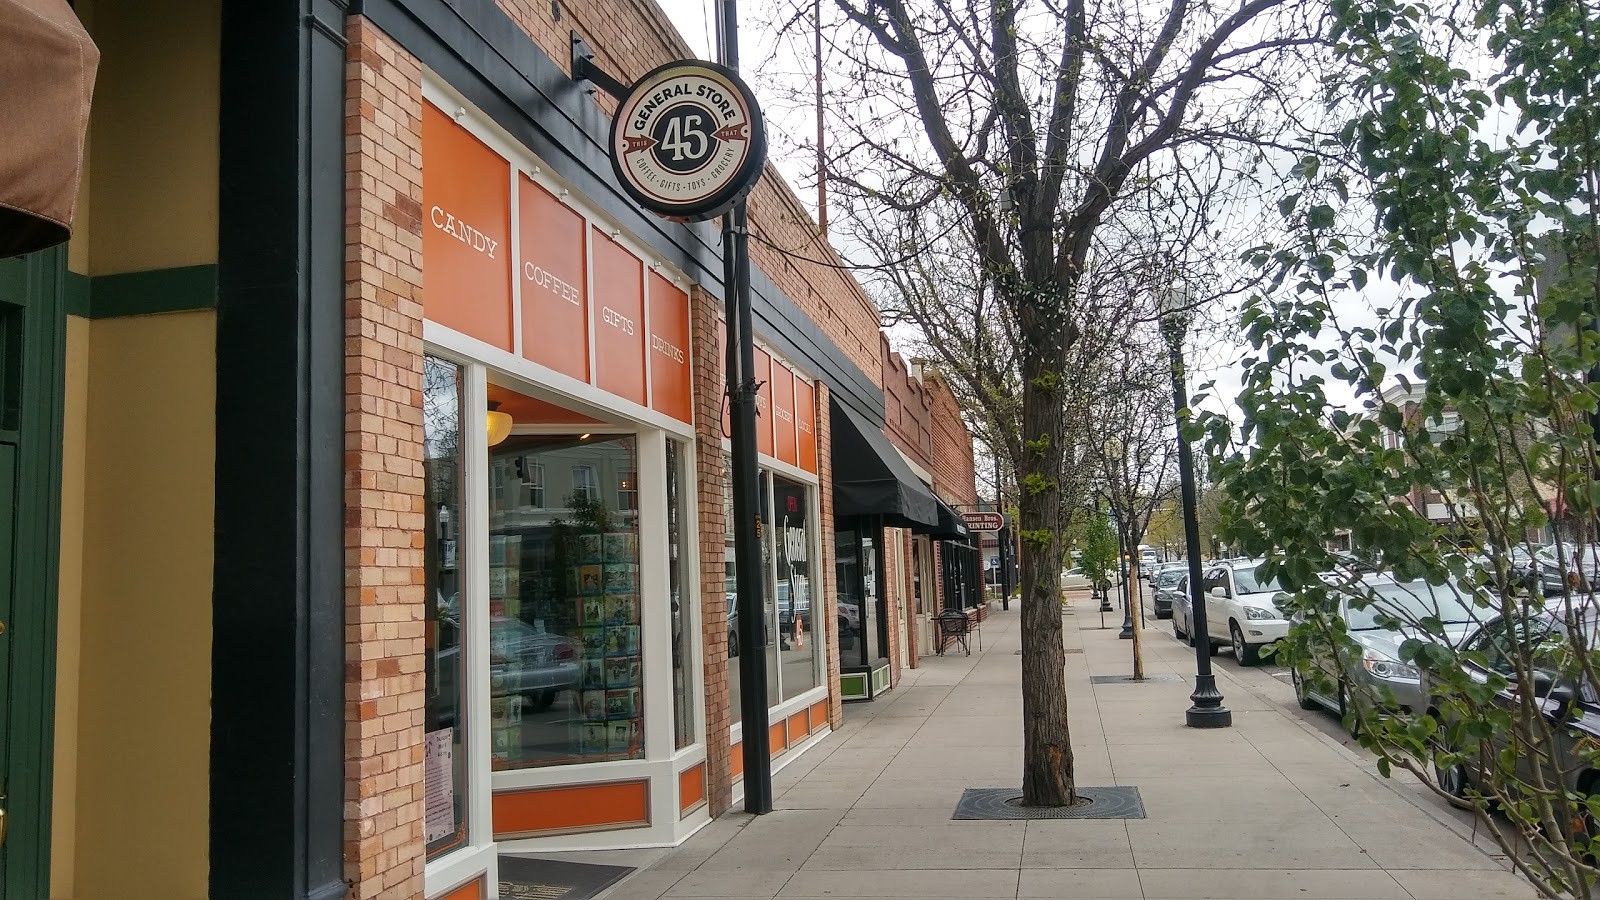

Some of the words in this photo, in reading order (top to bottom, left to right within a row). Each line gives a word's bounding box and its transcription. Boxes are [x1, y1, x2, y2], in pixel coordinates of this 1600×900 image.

[634, 83, 692, 131] GENERAL
[696, 84, 736, 121] STORE
[632, 140, 648, 148] THIS
[660, 114, 709, 161] 45
[636, 157, 657, 183] COFFEE
[659, 178, 681, 192] GIFTS
[687, 178, 706, 191] TOYS
[712, 147, 735, 179] GROCERY
[430, 205, 498, 259] CANDY
[524, 261, 580, 306] COFFEE
[602, 306, 634, 336] GIFTS
[652, 334, 684, 364] DRINKS
[783, 514, 807, 567] General
